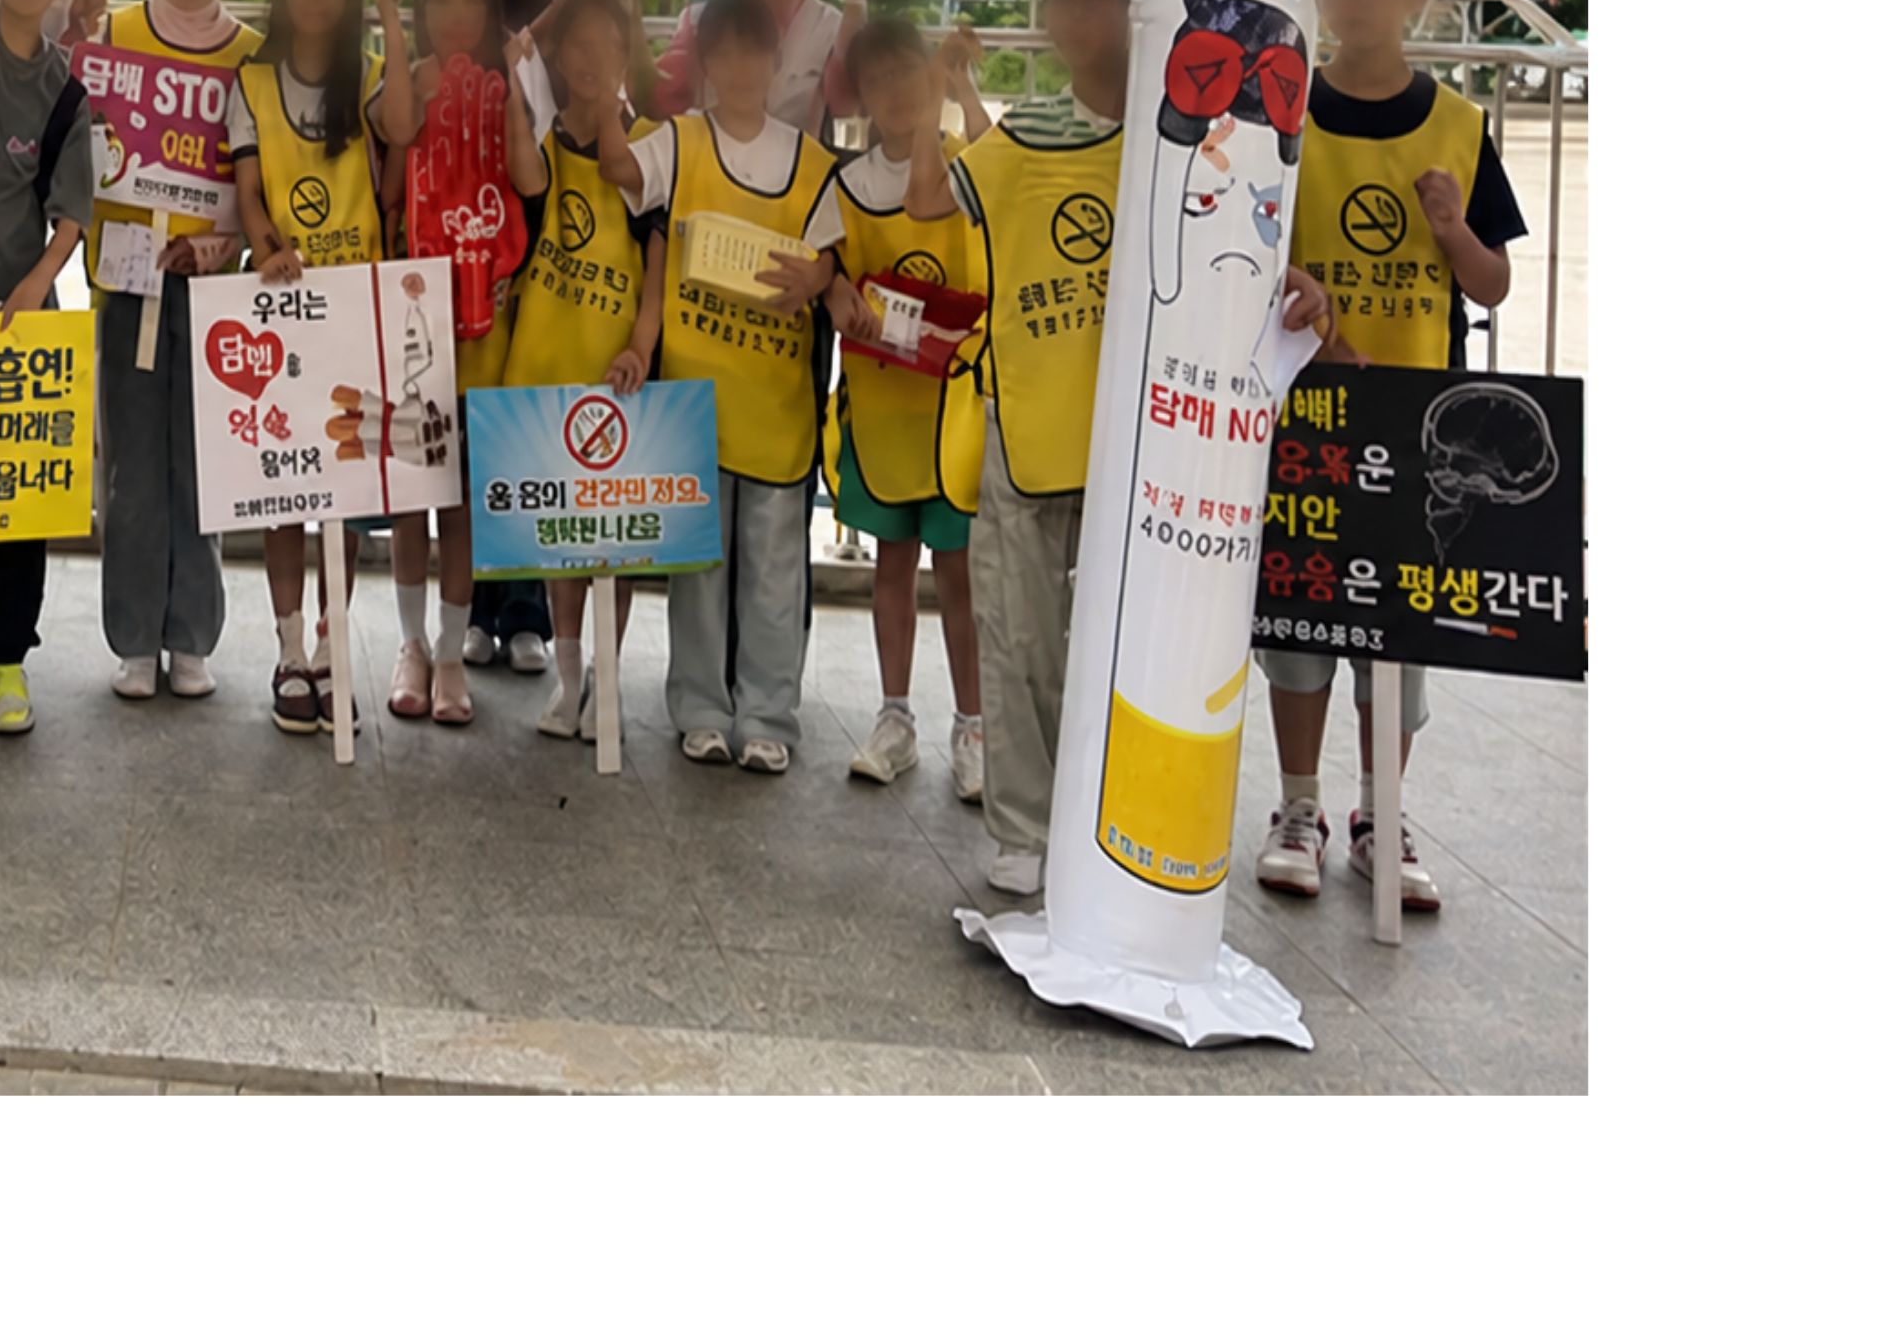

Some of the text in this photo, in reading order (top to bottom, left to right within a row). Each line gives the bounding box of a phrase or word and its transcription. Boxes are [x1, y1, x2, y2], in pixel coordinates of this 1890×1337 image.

[152, 66, 228, 125] STO
[251, 288, 328, 325] 우리는
[1396, 562, 1570, 624] 평생간다
